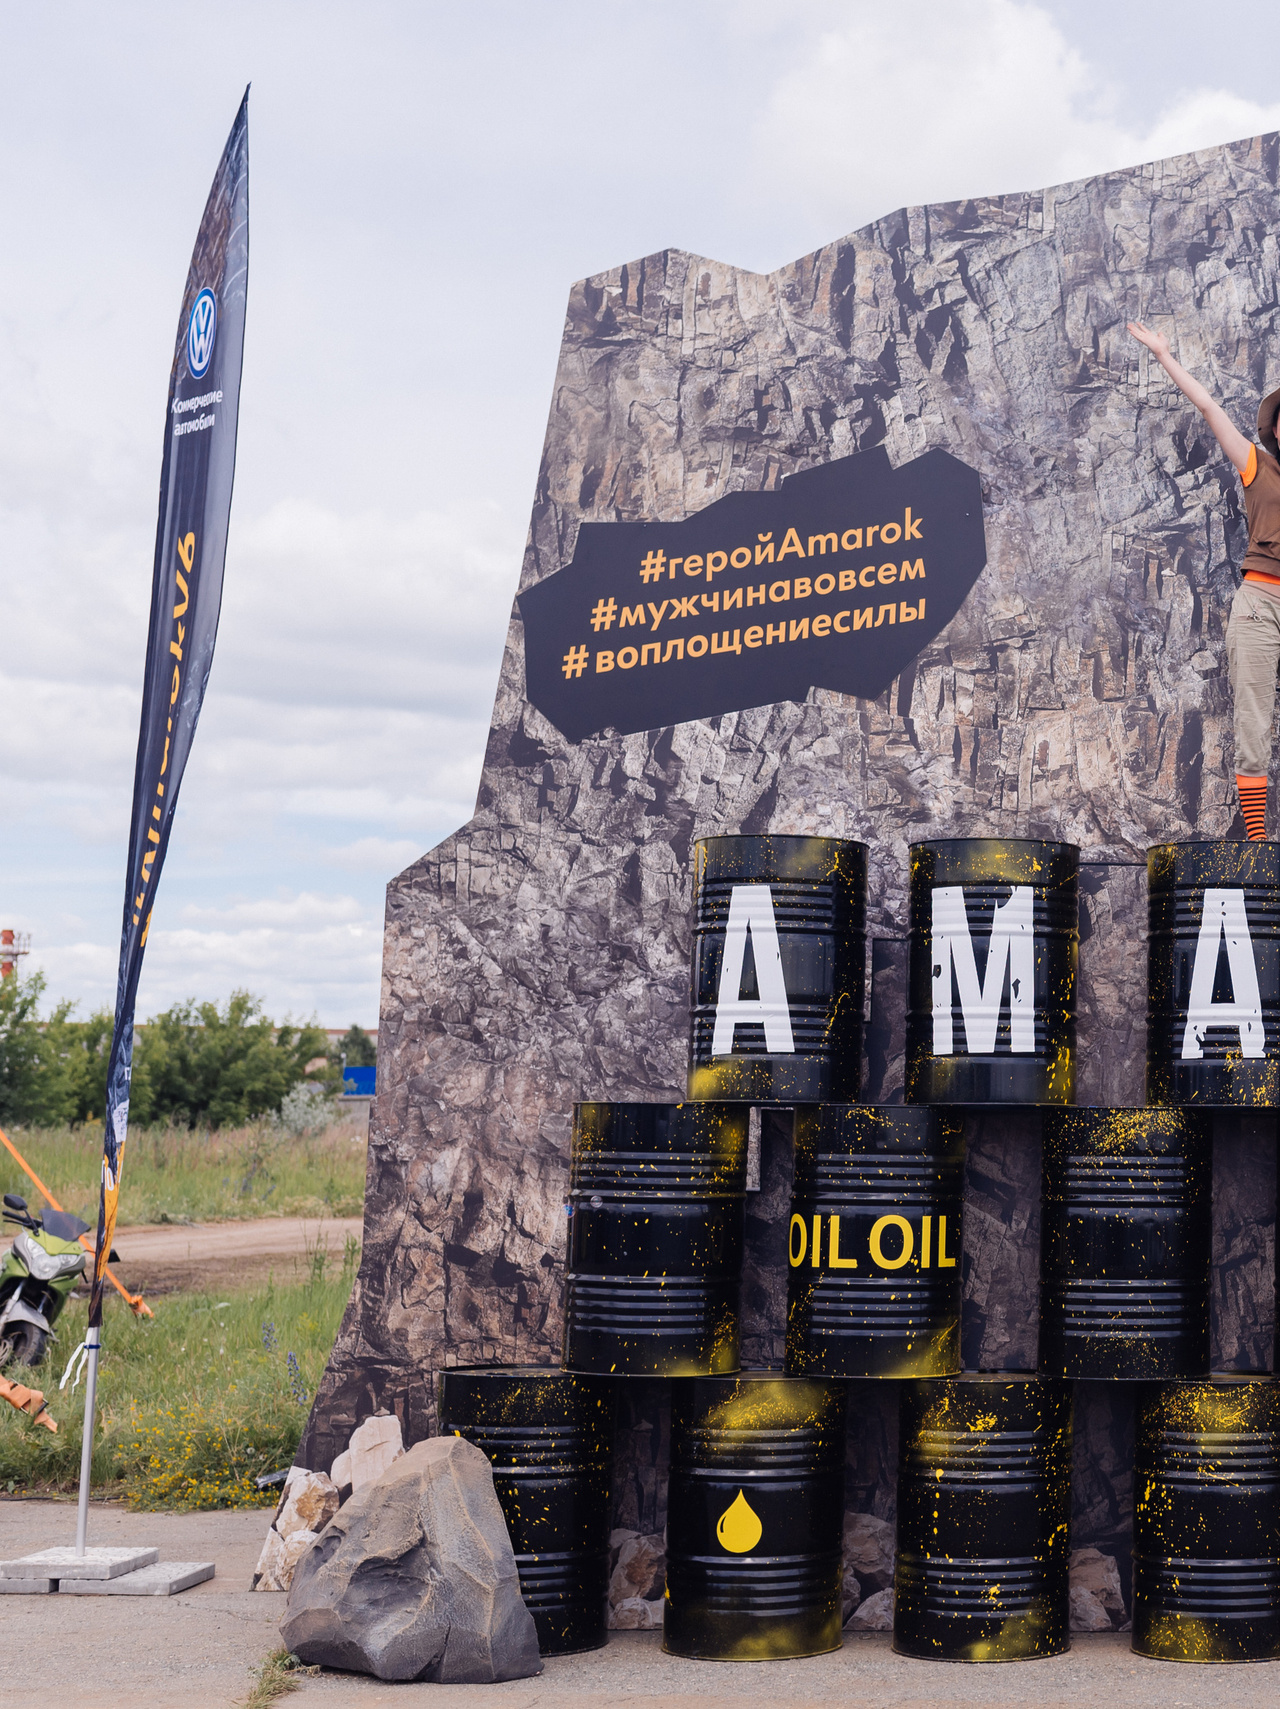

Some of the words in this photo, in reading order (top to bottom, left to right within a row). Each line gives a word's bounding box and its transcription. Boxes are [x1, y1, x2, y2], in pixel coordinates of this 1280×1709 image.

[639, 506, 924, 584] #геройAmarok
[589, 557, 927, 632] #мужчинавовсем
[788, 1213, 858, 1269] OIL
[868, 1214, 957, 1270] OIL
